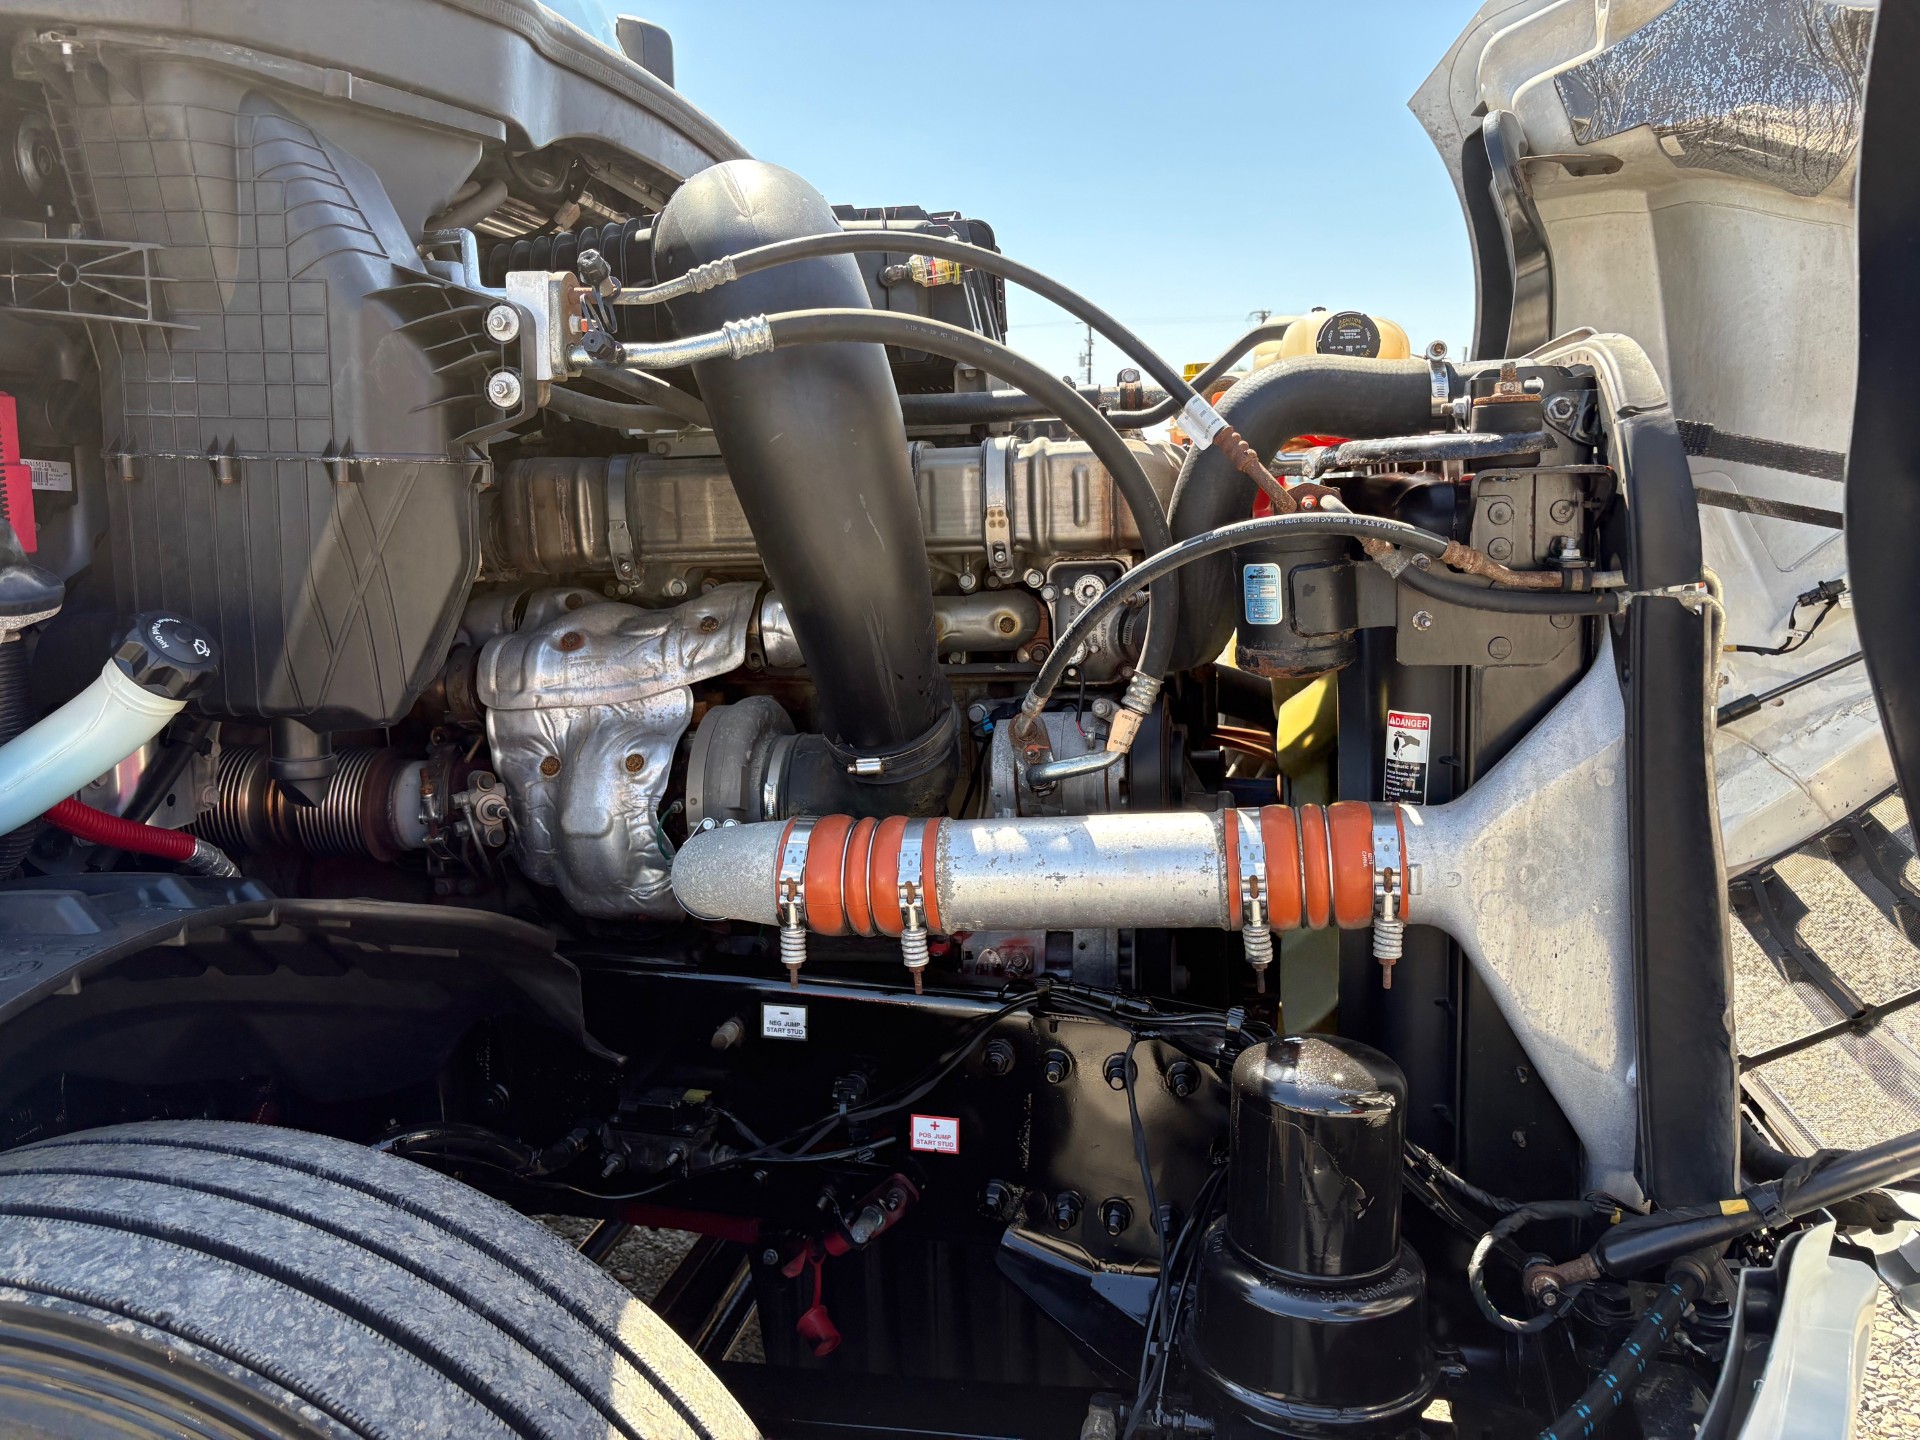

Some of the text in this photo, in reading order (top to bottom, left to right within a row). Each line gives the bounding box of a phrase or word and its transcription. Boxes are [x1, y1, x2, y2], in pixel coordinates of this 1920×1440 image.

[1349, 517, 1362, 525] SLE
[1363, 519, 1400, 531] GALAXY
[155, 635, 169, 649] Only
[1396, 718, 1428, 728] DANGER
[937, 1140, 954, 1148] STUD
[1319, 1289, 1353, 1303] OPEN
